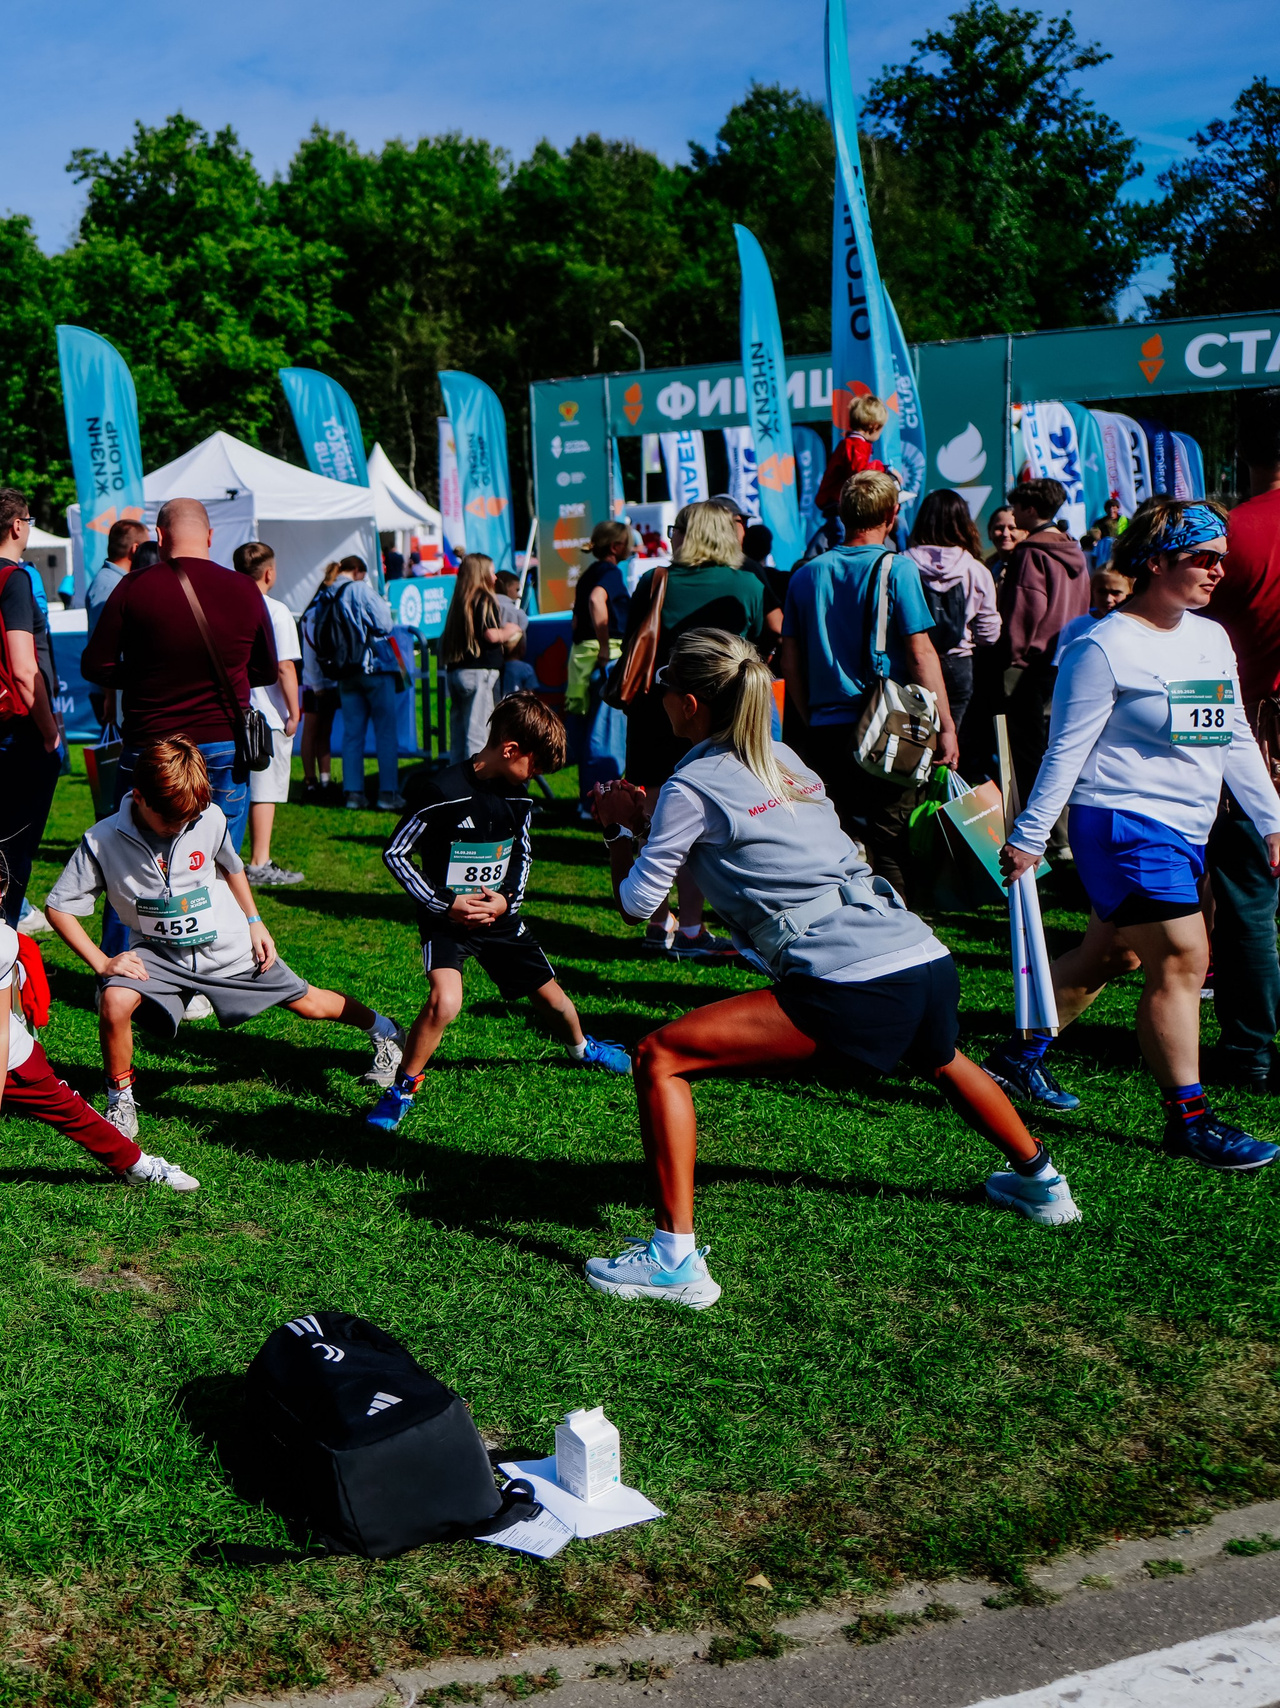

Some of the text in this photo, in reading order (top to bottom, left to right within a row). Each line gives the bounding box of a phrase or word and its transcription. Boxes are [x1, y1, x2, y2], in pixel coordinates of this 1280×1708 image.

[901, 375, 919, 429] CLUB
[1190, 708, 1225, 728] 138
[748, 802, 768, 817] МЫ
[464, 864, 503, 882] 888
[154, 917, 199, 936] 452
